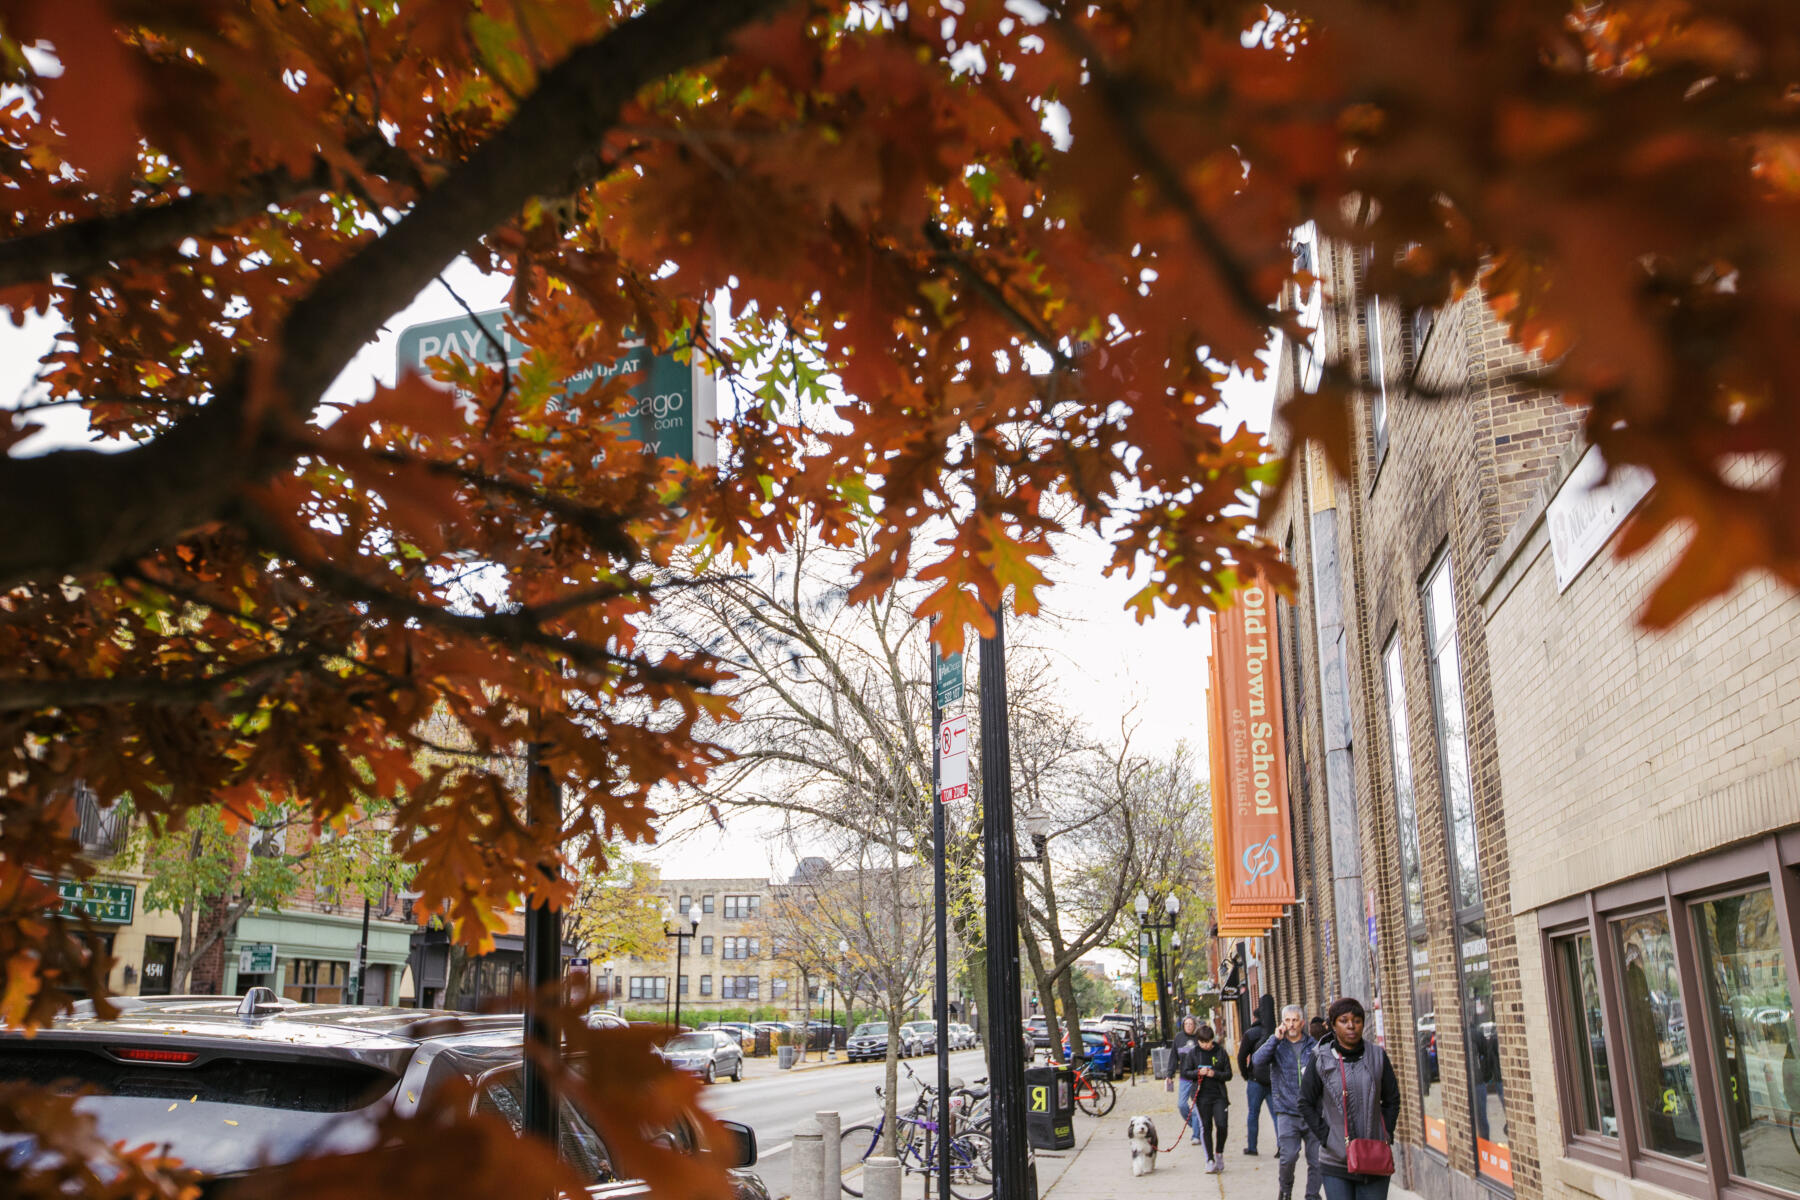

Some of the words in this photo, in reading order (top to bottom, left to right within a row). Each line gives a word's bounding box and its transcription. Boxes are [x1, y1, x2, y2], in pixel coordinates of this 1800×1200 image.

[419, 329, 483, 368] PAY
[621, 358, 640, 374] AT
[1243, 587, 1266, 635] Old
[1246, 638, 1268, 717] Town
[1232, 709, 1247, 724] of
[1233, 725, 1249, 764] Folk
[1250, 722, 1278, 816] School
[1235, 767, 1251, 816] Music
